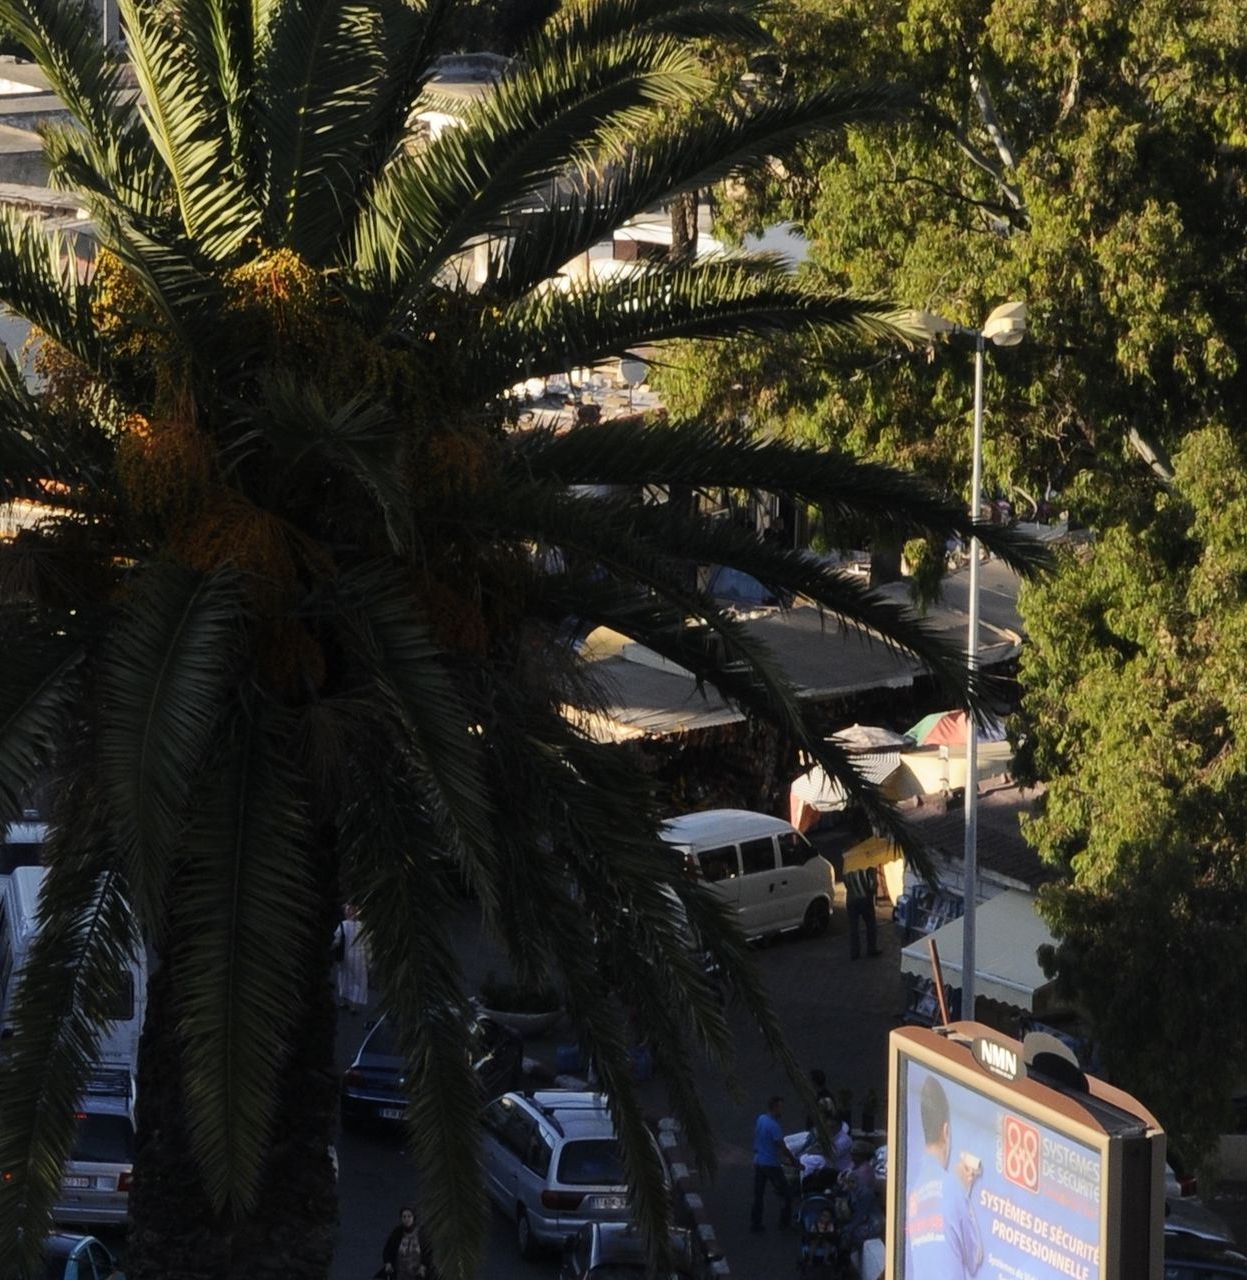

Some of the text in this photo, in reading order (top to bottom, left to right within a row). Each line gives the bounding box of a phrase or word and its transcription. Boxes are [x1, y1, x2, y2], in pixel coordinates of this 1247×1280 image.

[981, 1039, 1017, 1075] NMN
[980, 1189, 1033, 1230] SYSTÈMES
[1033, 1217, 1049, 1237] DE
[1049, 1224, 1100, 1265] SÉCURITÉ
